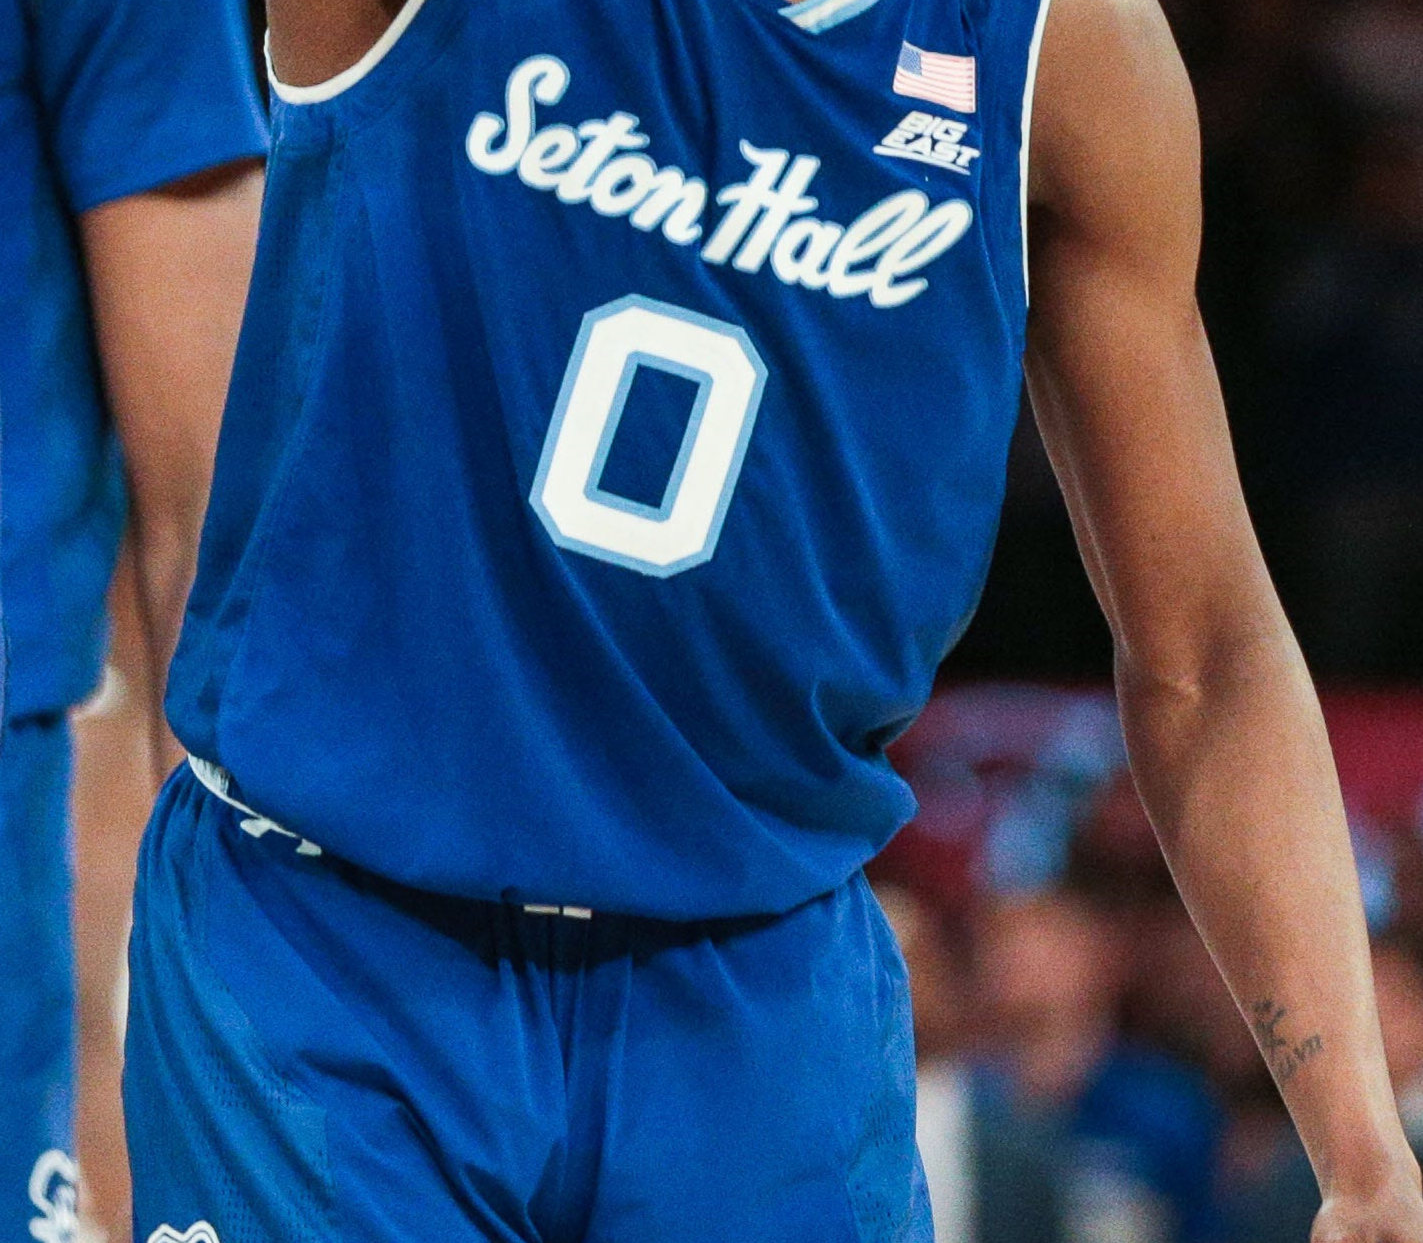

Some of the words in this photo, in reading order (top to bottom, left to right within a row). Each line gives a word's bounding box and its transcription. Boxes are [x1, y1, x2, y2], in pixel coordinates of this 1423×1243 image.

[466, 54, 708, 246] Seton
[699, 138, 974, 309] Hall
[881, 127, 980, 167] EAST
[897, 110, 968, 143] BIG
[529, 294, 769, 579] 0
